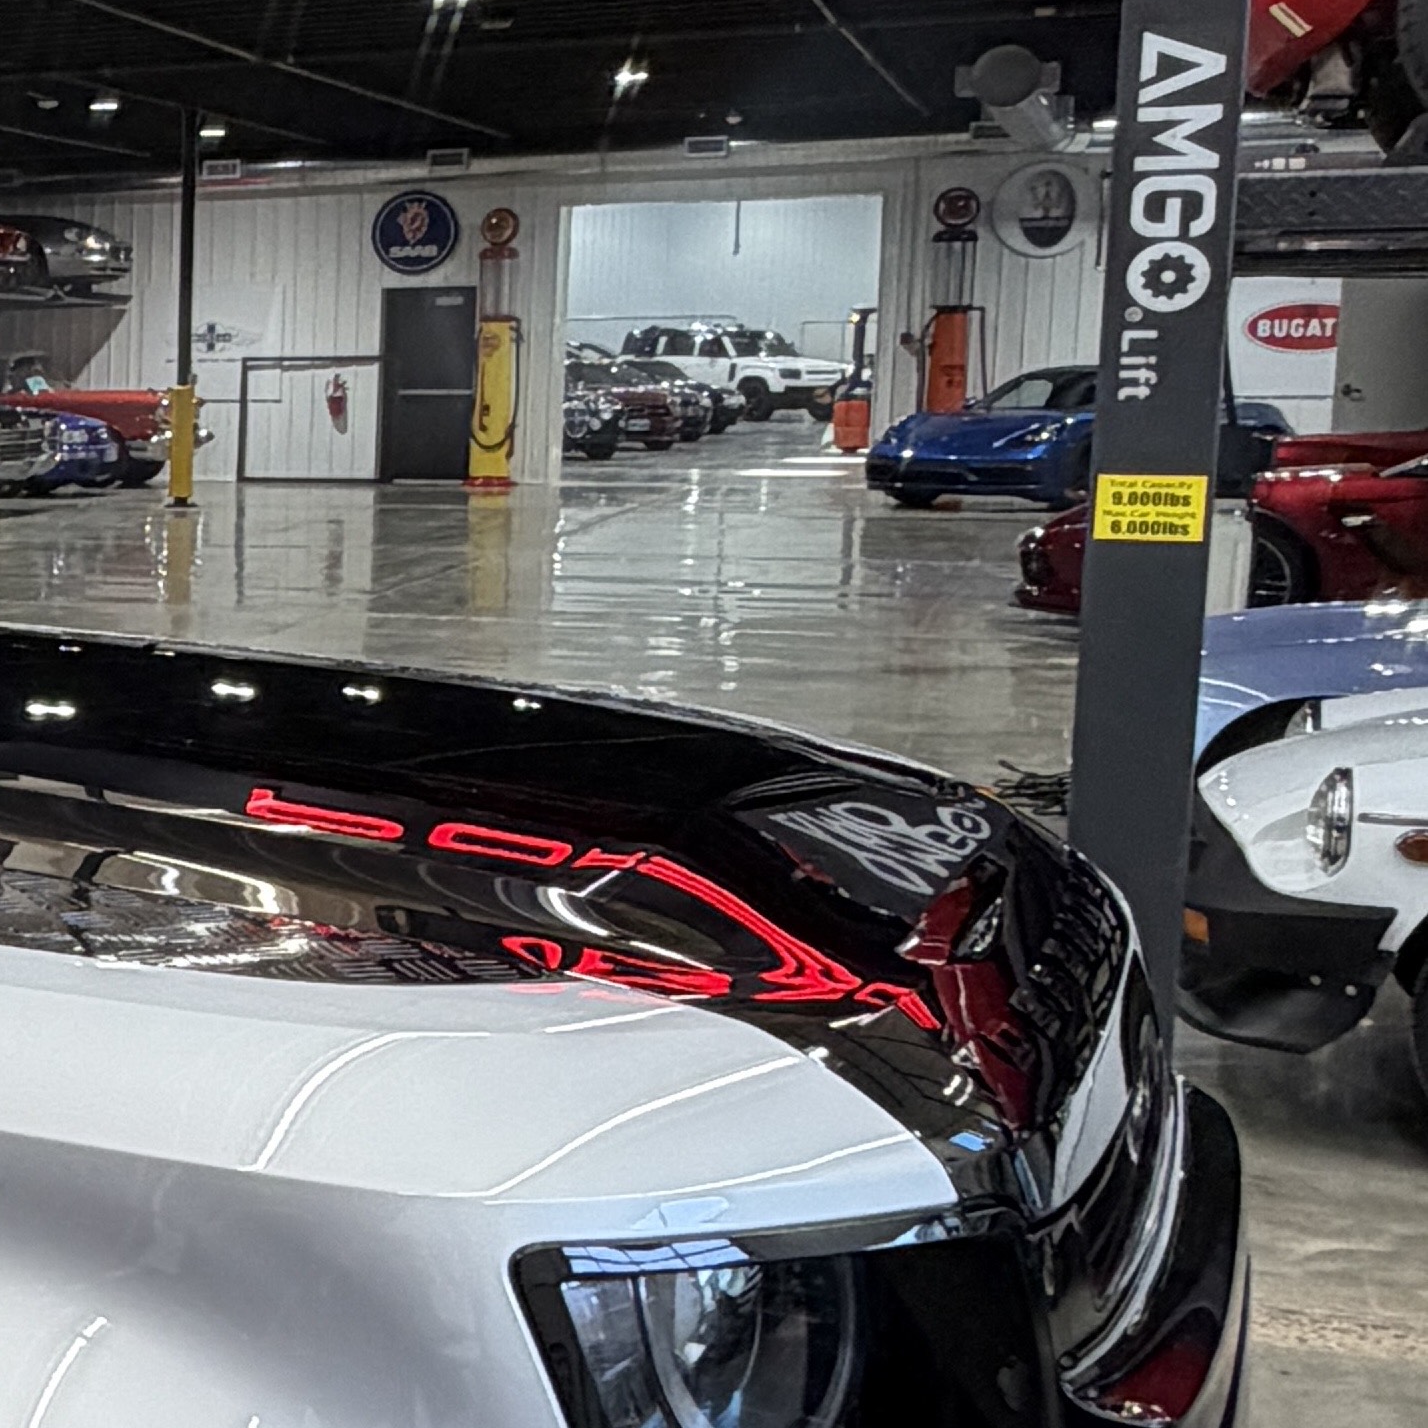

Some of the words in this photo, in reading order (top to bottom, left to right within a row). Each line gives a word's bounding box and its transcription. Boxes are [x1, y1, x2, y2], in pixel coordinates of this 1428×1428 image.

[1125, 30, 1228, 314] AMGO
[1256, 316, 1338, 338] BUGAT
[1117, 329, 1160, 402] Lift
